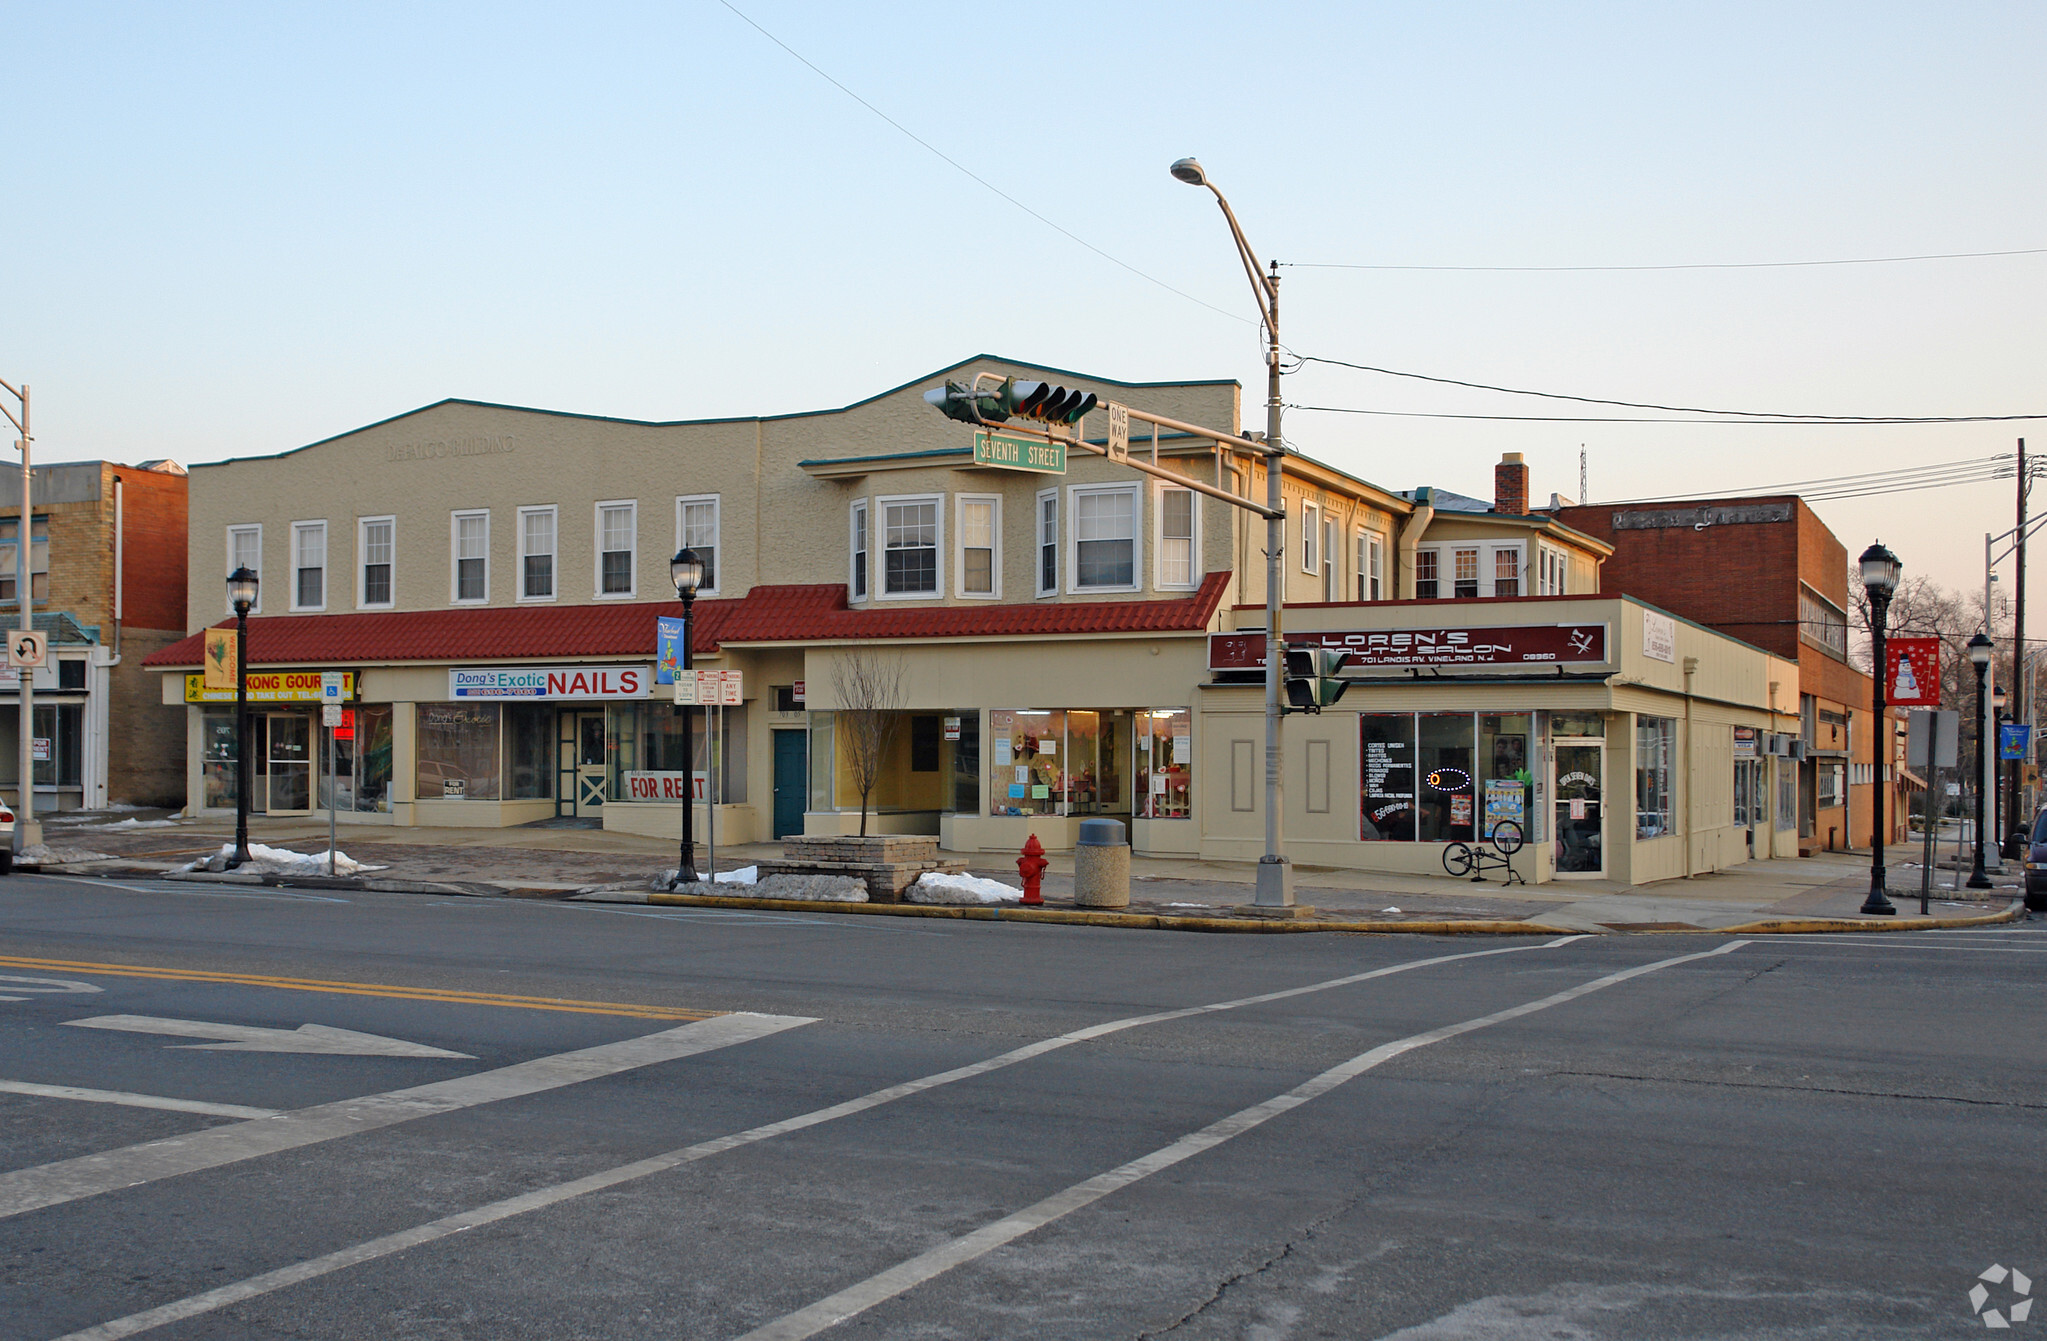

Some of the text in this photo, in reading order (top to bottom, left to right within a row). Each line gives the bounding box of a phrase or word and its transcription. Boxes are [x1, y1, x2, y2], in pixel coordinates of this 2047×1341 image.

[1111, 407, 1126, 424] ONE
[1111, 425, 1127, 441] WAY
[980, 439, 1060, 467] SEVENTH STREET
[1322, 631, 1469, 646] LOREN'S
[1417, 644, 1512, 654] SALON
[229, 635, 237, 684] WELCOME
[1362, 656, 1376, 664] 701
[1378, 655, 1411, 664] LANDIS
[1428, 655, 1474, 663] VINELAND
[286, 674, 351, 689] GOURT
[457, 671, 639, 694] Dong's Exotic NAILS
[203, 692, 233, 700] CHINESE
[444, 786, 464, 795] RENT
[631, 778, 659, 798] FOR
